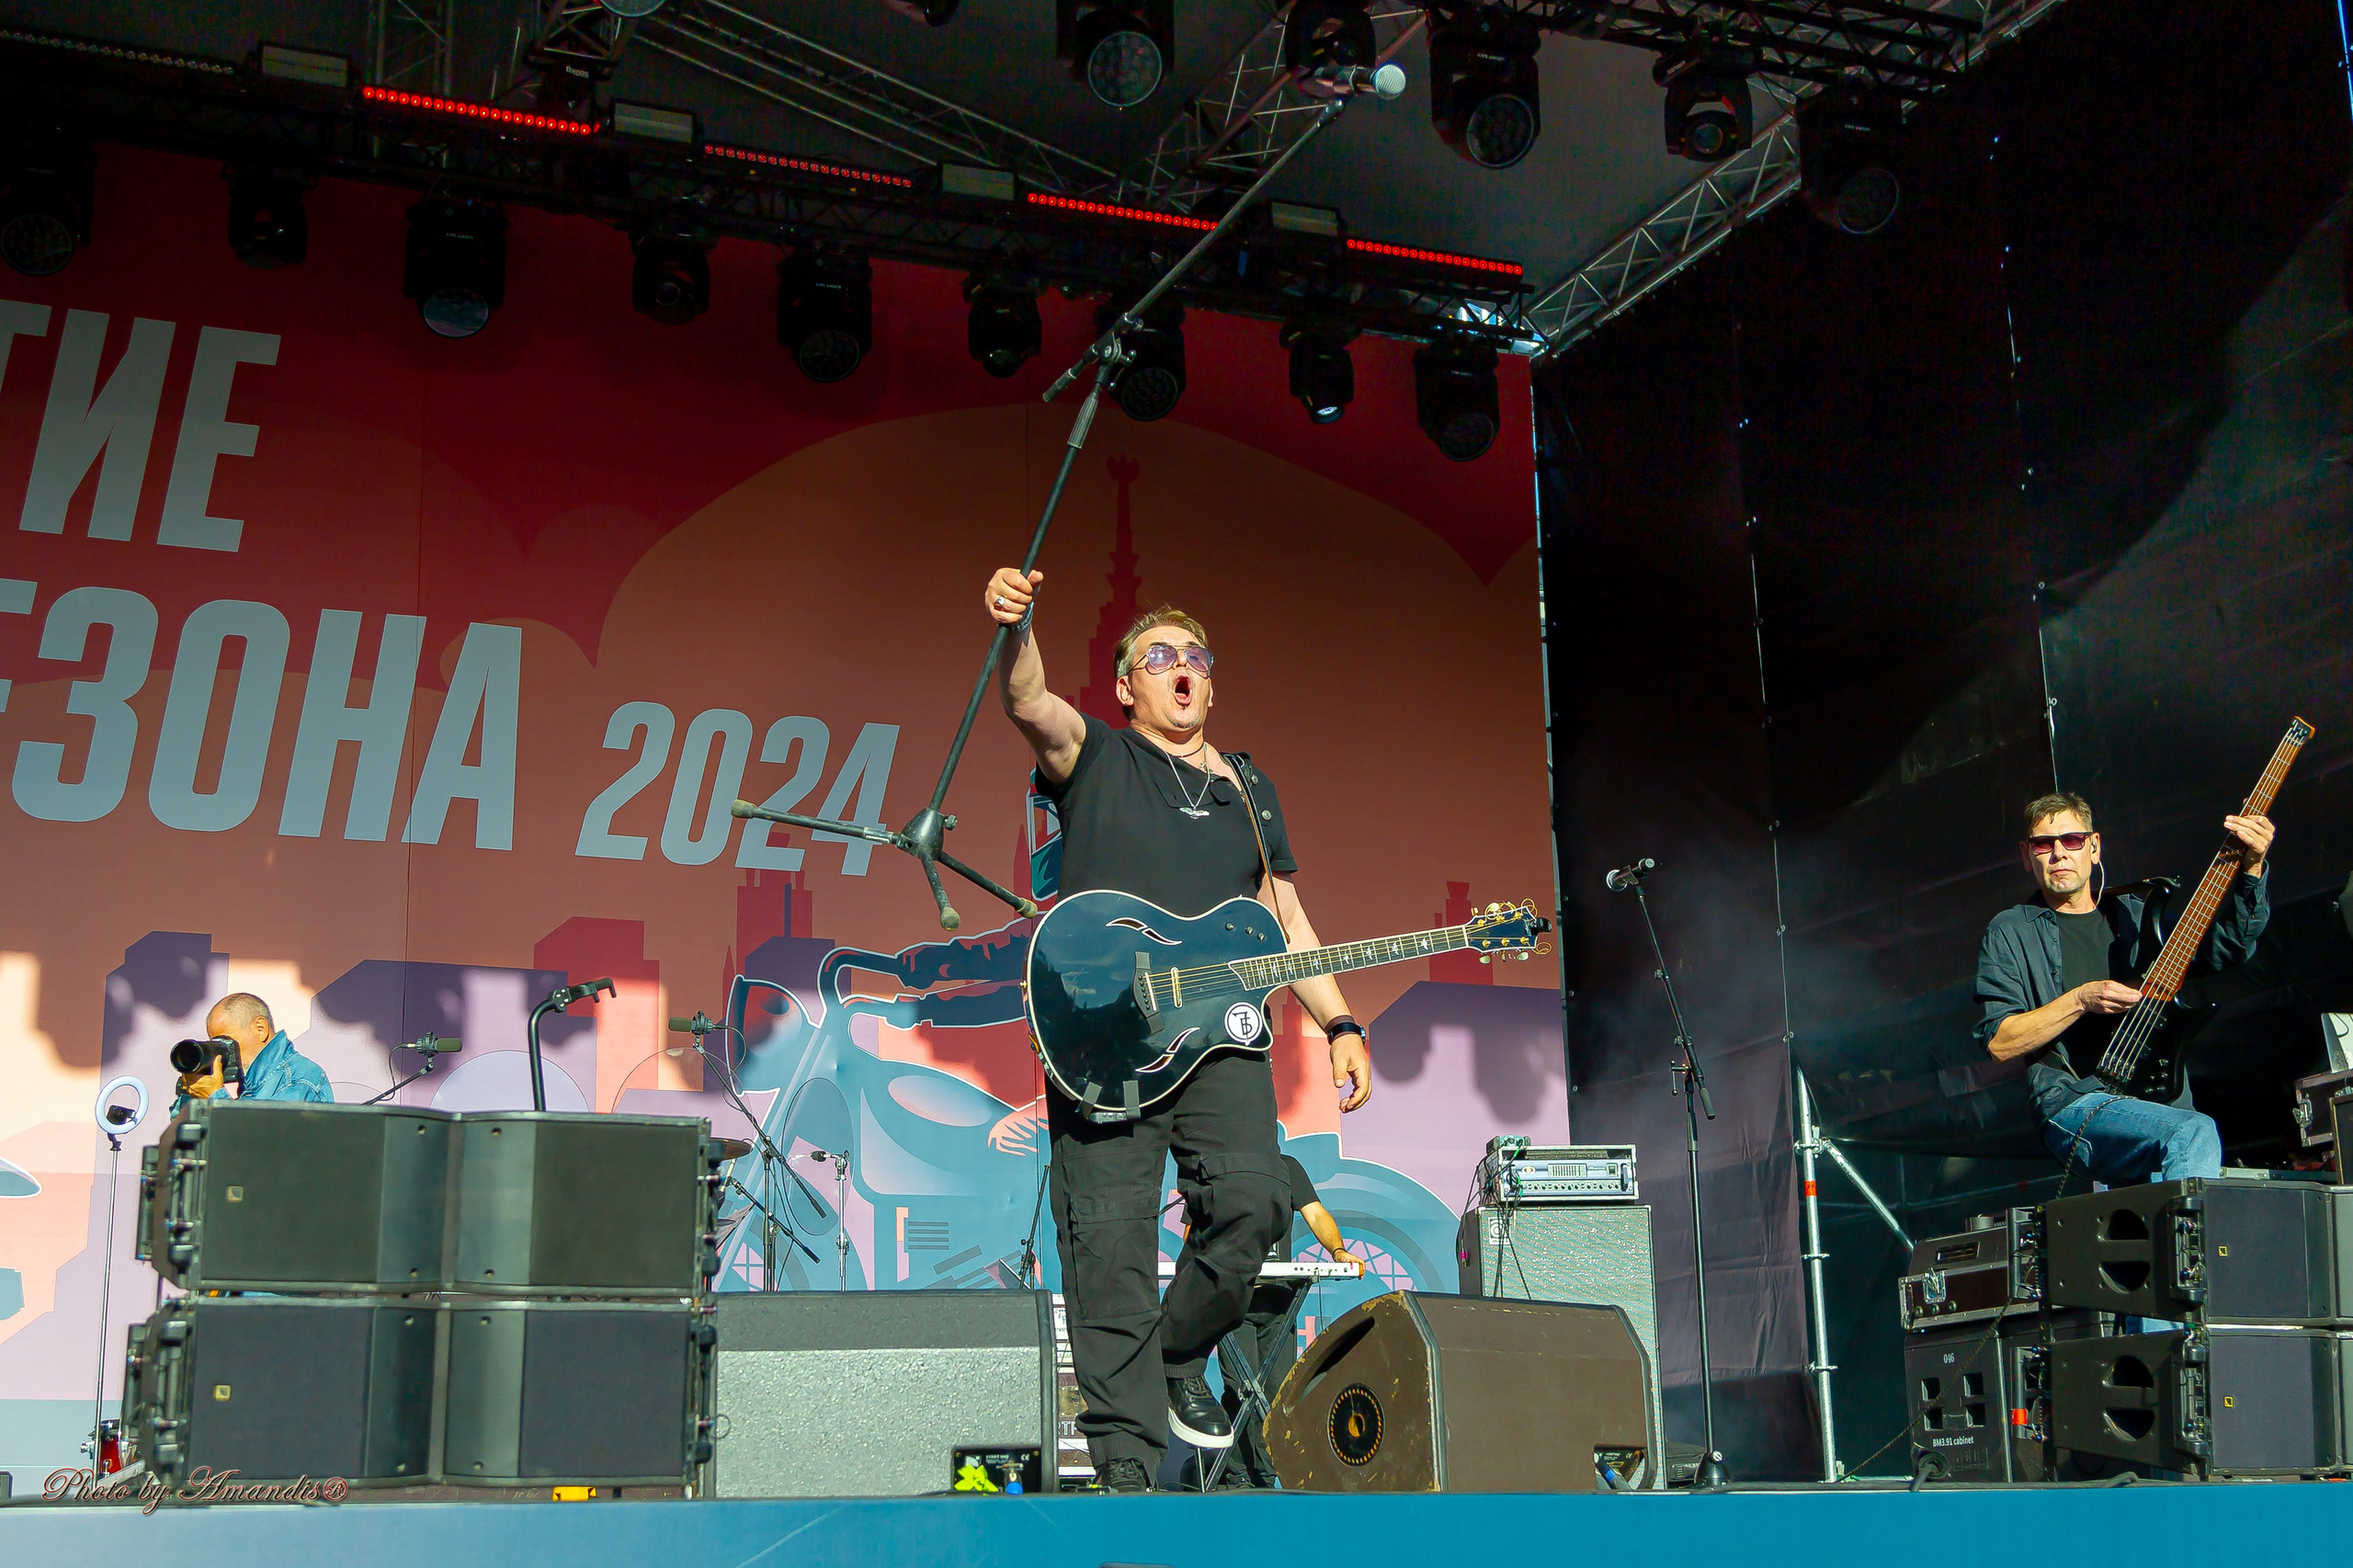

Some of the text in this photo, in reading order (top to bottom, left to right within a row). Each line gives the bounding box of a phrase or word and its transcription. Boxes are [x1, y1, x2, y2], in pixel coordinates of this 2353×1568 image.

[575, 701, 900, 877] 2024
[1943, 1353, 1955, 1364] 046
[1932, 1436, 1974, 1448] BM3.91 cabinet
